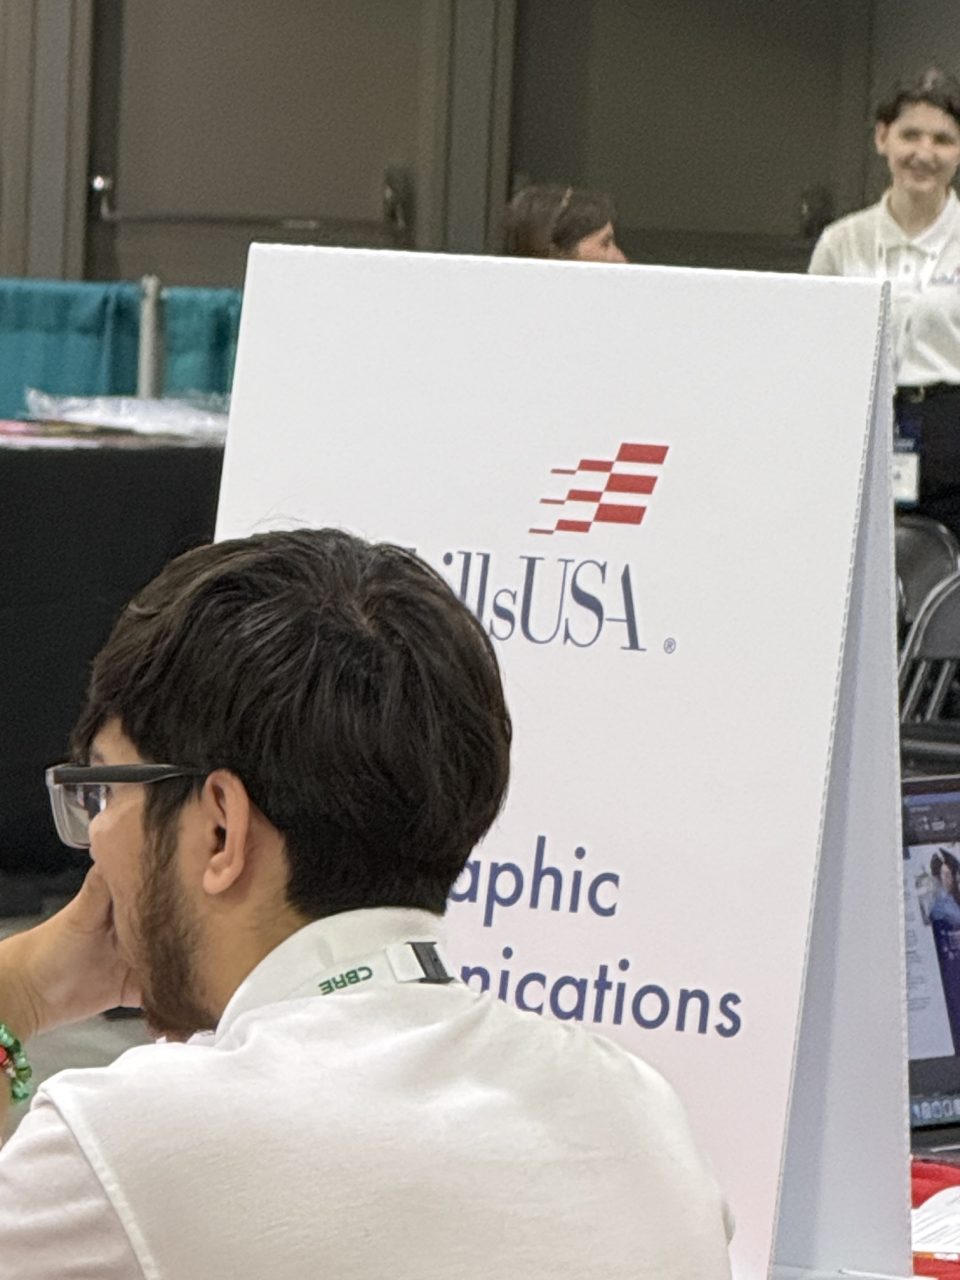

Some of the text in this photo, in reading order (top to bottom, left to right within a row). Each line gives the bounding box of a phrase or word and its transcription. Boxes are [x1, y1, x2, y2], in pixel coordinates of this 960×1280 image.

[442, 551, 647, 652] llsUSA
[450, 835, 620, 928] aphic
[318, 965, 374, 996] CBRE
[460, 946, 743, 1038] nications
